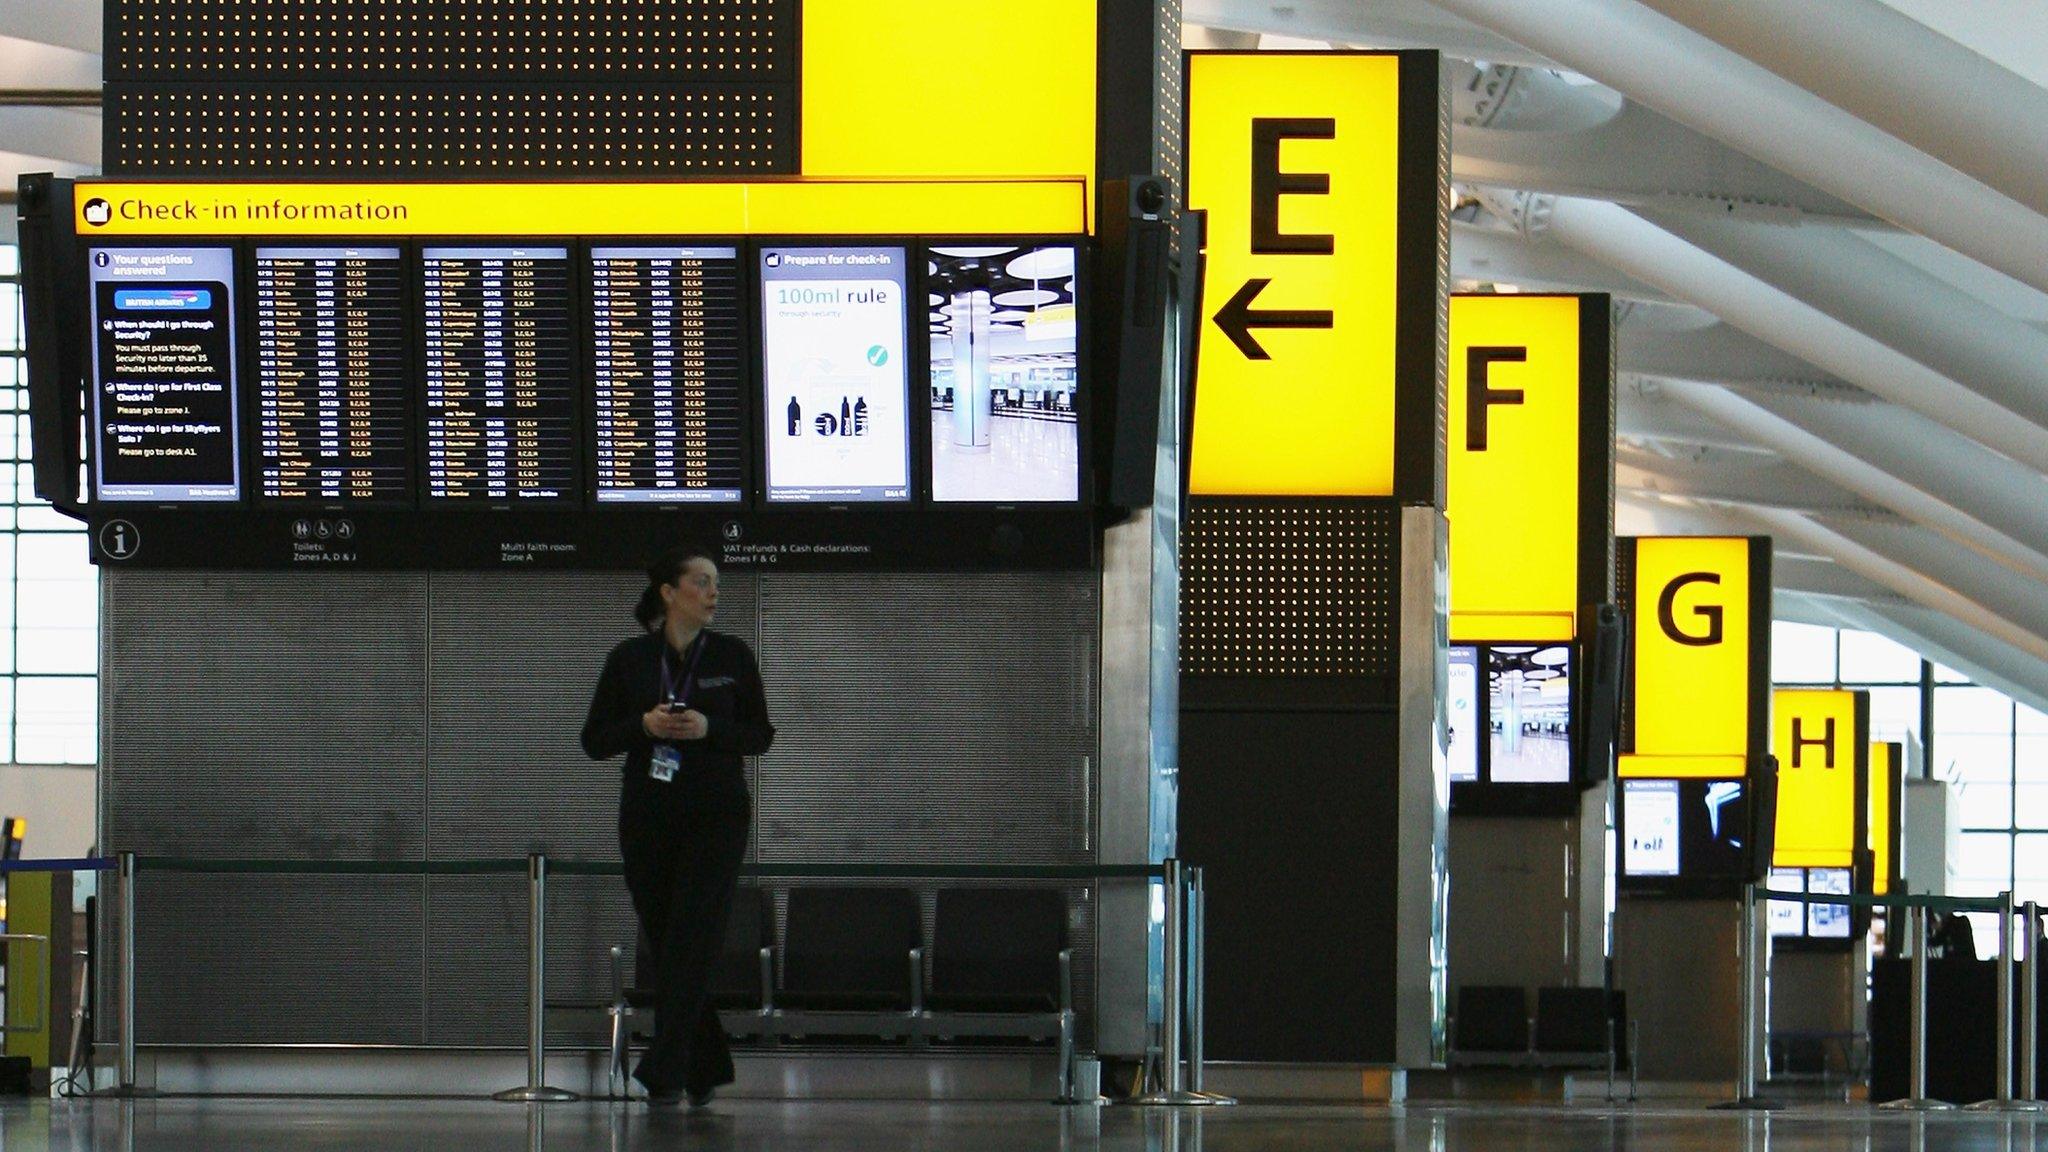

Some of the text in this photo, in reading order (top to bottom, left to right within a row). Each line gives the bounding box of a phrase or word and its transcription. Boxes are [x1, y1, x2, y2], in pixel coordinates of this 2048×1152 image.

[1251, 117, 1336, 256] E
[120, 199, 408, 219] Check-in information
[112, 254, 193, 268] Your questions
[784, 254, 891, 266] Prepare for check-in
[113, 265, 166, 276] answered
[778, 288, 886, 304] 100ml rule
[114, 321, 138, 329] When
[138, 321, 165, 329] should
[170, 322, 181, 330] go
[182, 321, 214, 331] through
[114, 332, 151, 340] Security?
[116, 344, 130, 352] You
[152, 346, 169, 354] pass
[170, 344, 202, 354] through
[115, 354, 146, 364] Security
[159, 354, 177, 362] later
[178, 354, 197, 362] than
[116, 365, 147, 373] minutes
[148, 364, 174, 373] before
[116, 383, 142, 391] Where
[143, 383, 154, 391] do
[159, 384, 170, 392] go
[171, 383, 183, 391] for
[184, 383, 202, 391] First
[1466, 346, 1527, 451] F
[117, 406, 142, 414] Please
[142, 408, 154, 416] go
[118, 425, 144, 434] Where
[144, 425, 156, 433] do
[160, 426, 172, 434] go
[172, 425, 184, 433] for
[118, 448, 143, 456] Please
[144, 450, 155, 458] go
[156, 448, 165, 456] to
[294, 543, 324, 551] Toilets:
[501, 543, 525, 551] Multi
[527, 543, 548, 551] faith
[722, 544, 741, 552] VAT
[743, 544, 778, 552] refunds
[780, 544, 787, 552] &
[790, 544, 812, 552] Cash
[322, 553, 332, 562] A,
[724, 554, 750, 562] Zones
[760, 554, 767, 562] &
[769, 554, 776, 562] G
[1657, 573, 1723, 646] G
[1790, 716, 1835, 769] H
